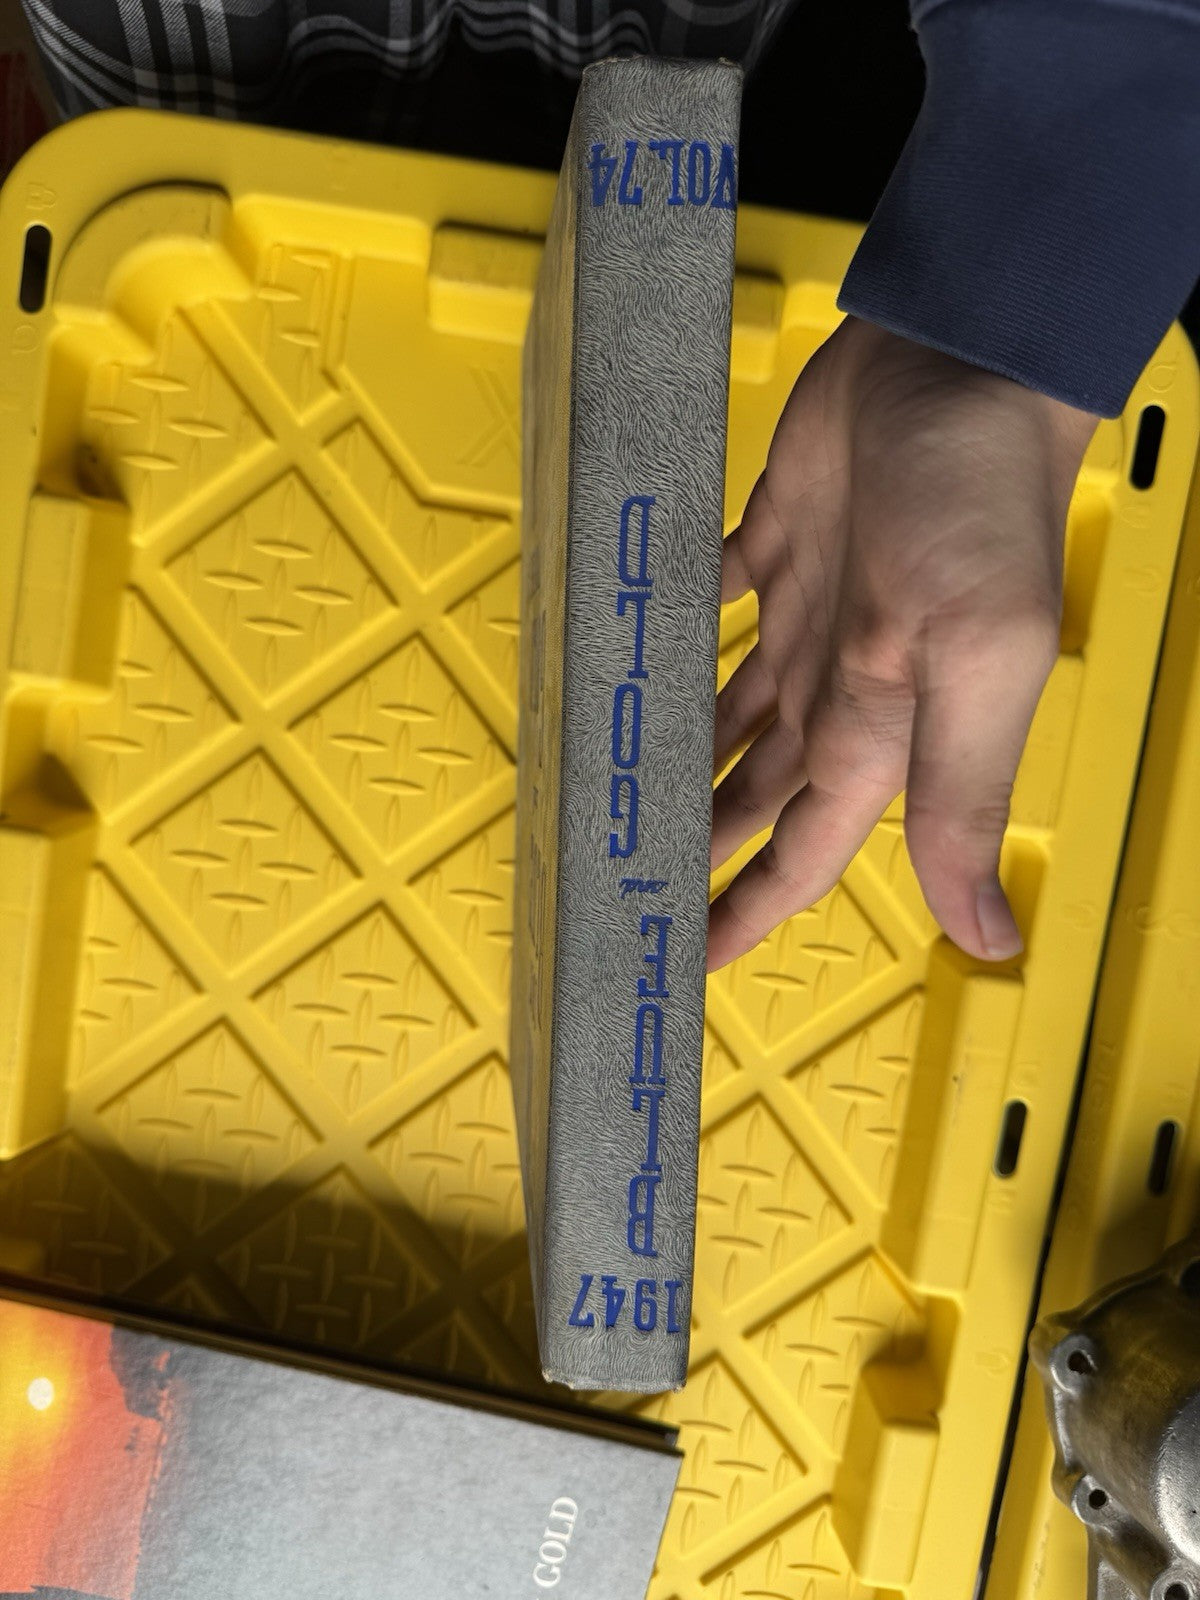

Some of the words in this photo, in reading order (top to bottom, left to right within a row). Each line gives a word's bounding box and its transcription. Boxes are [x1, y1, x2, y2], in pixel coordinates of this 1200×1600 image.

[587, 140, 643, 207] 74
[619, 877, 669, 900] and
[568, 1273, 682, 1333] 1947
[532, 1496, 579, 1589] GOLD
